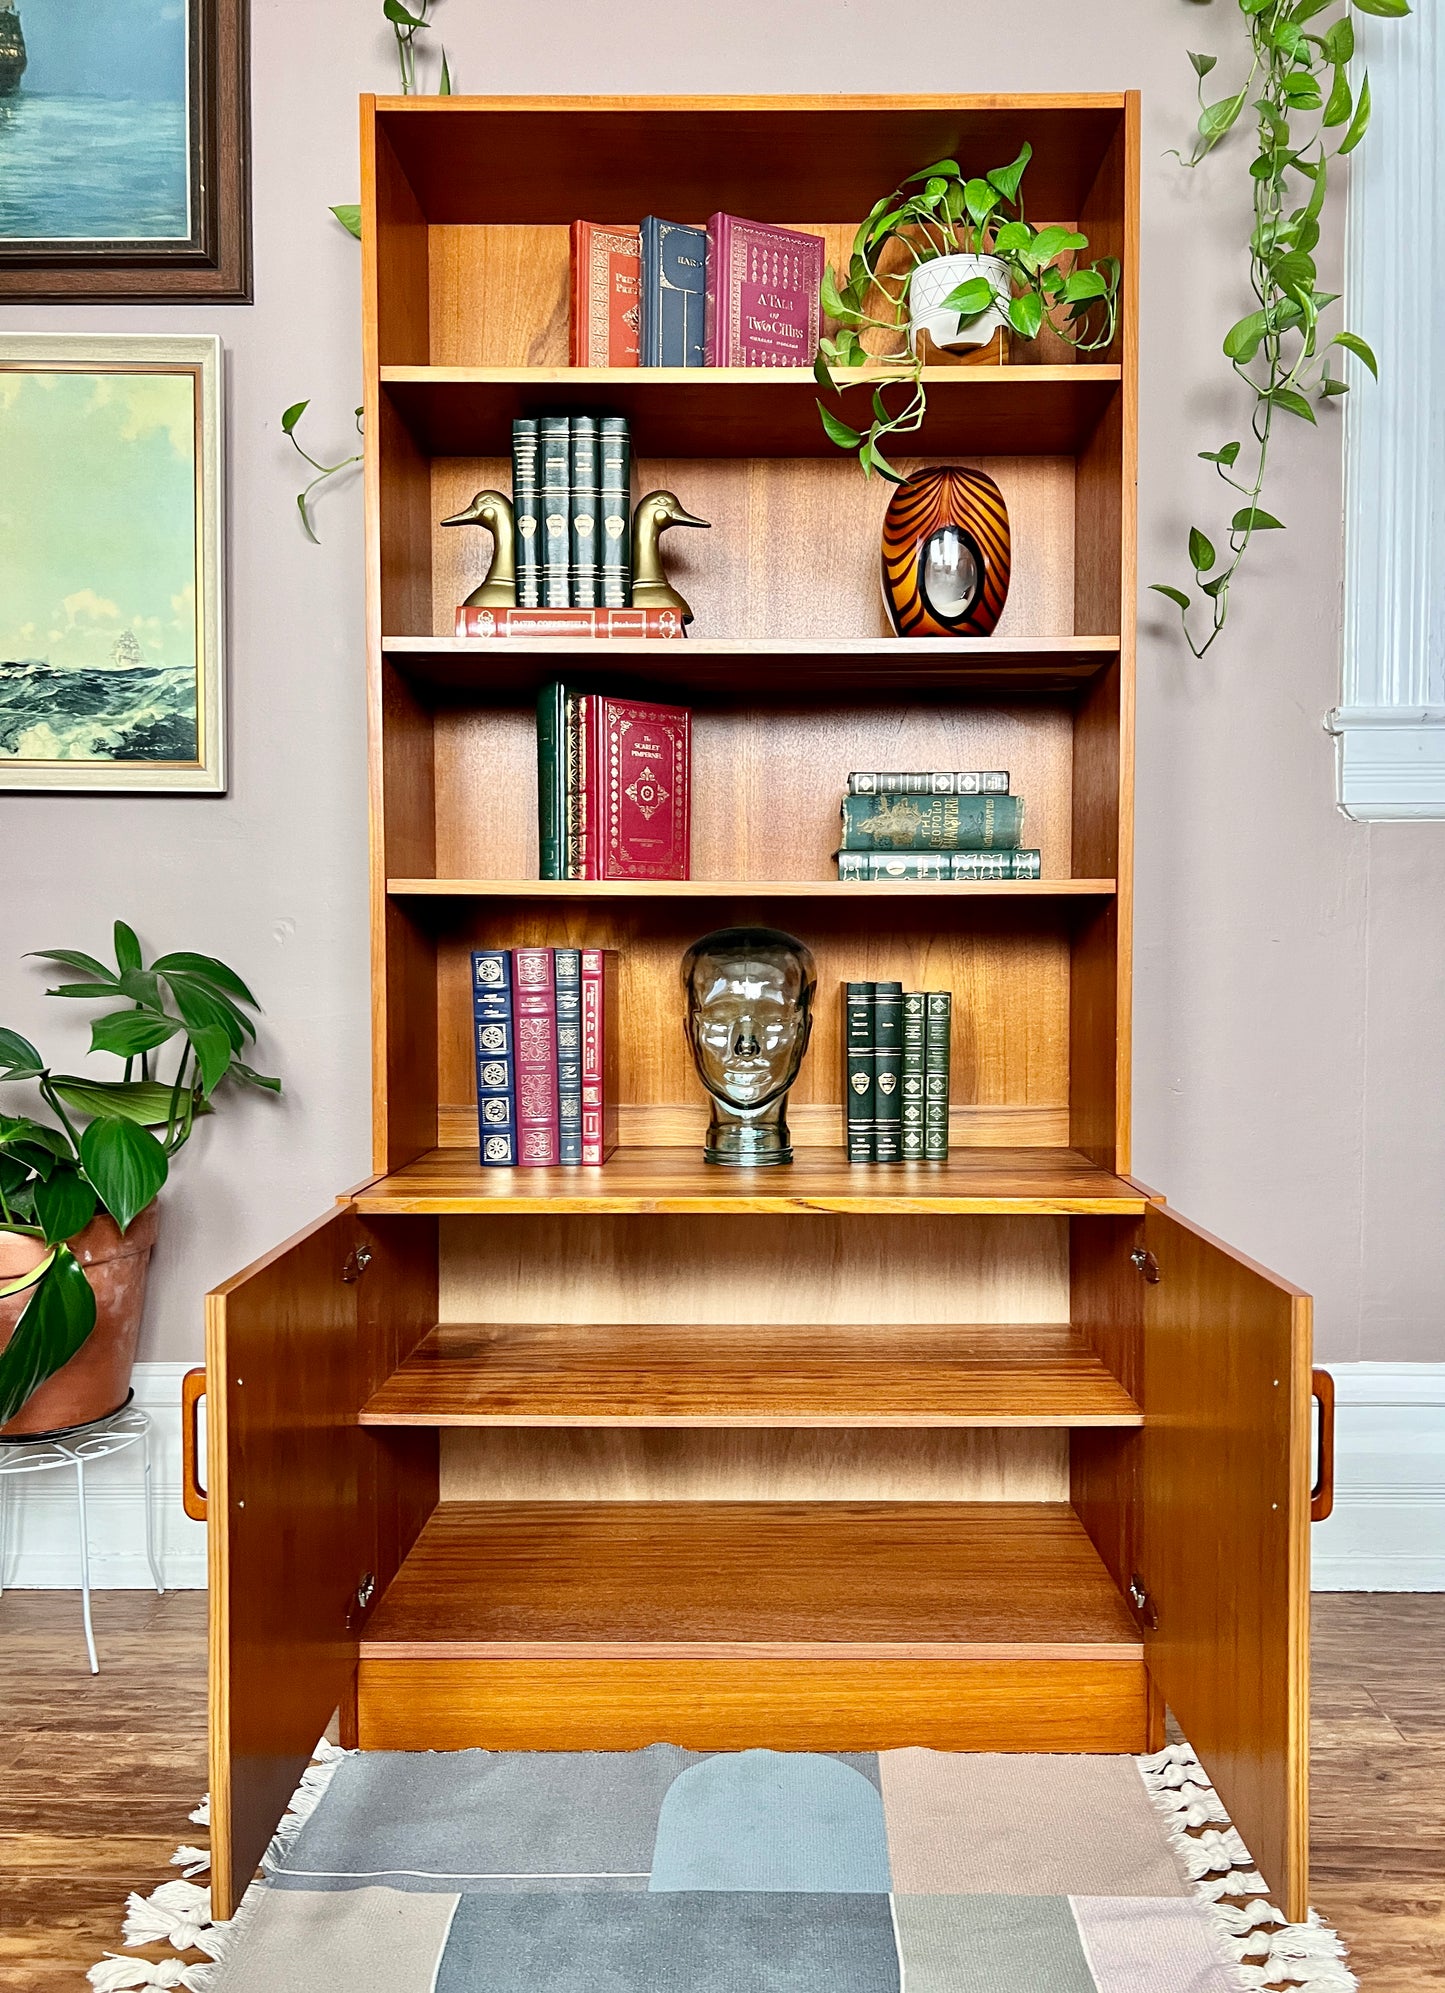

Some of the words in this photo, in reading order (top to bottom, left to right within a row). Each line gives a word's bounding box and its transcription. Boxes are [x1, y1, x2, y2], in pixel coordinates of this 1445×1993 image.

[757, 293, 767, 306] A
[633, 742, 661, 752] SCARLET
[631, 750, 664, 760] PIMPERNEL
[921, 808, 932, 838] THE
